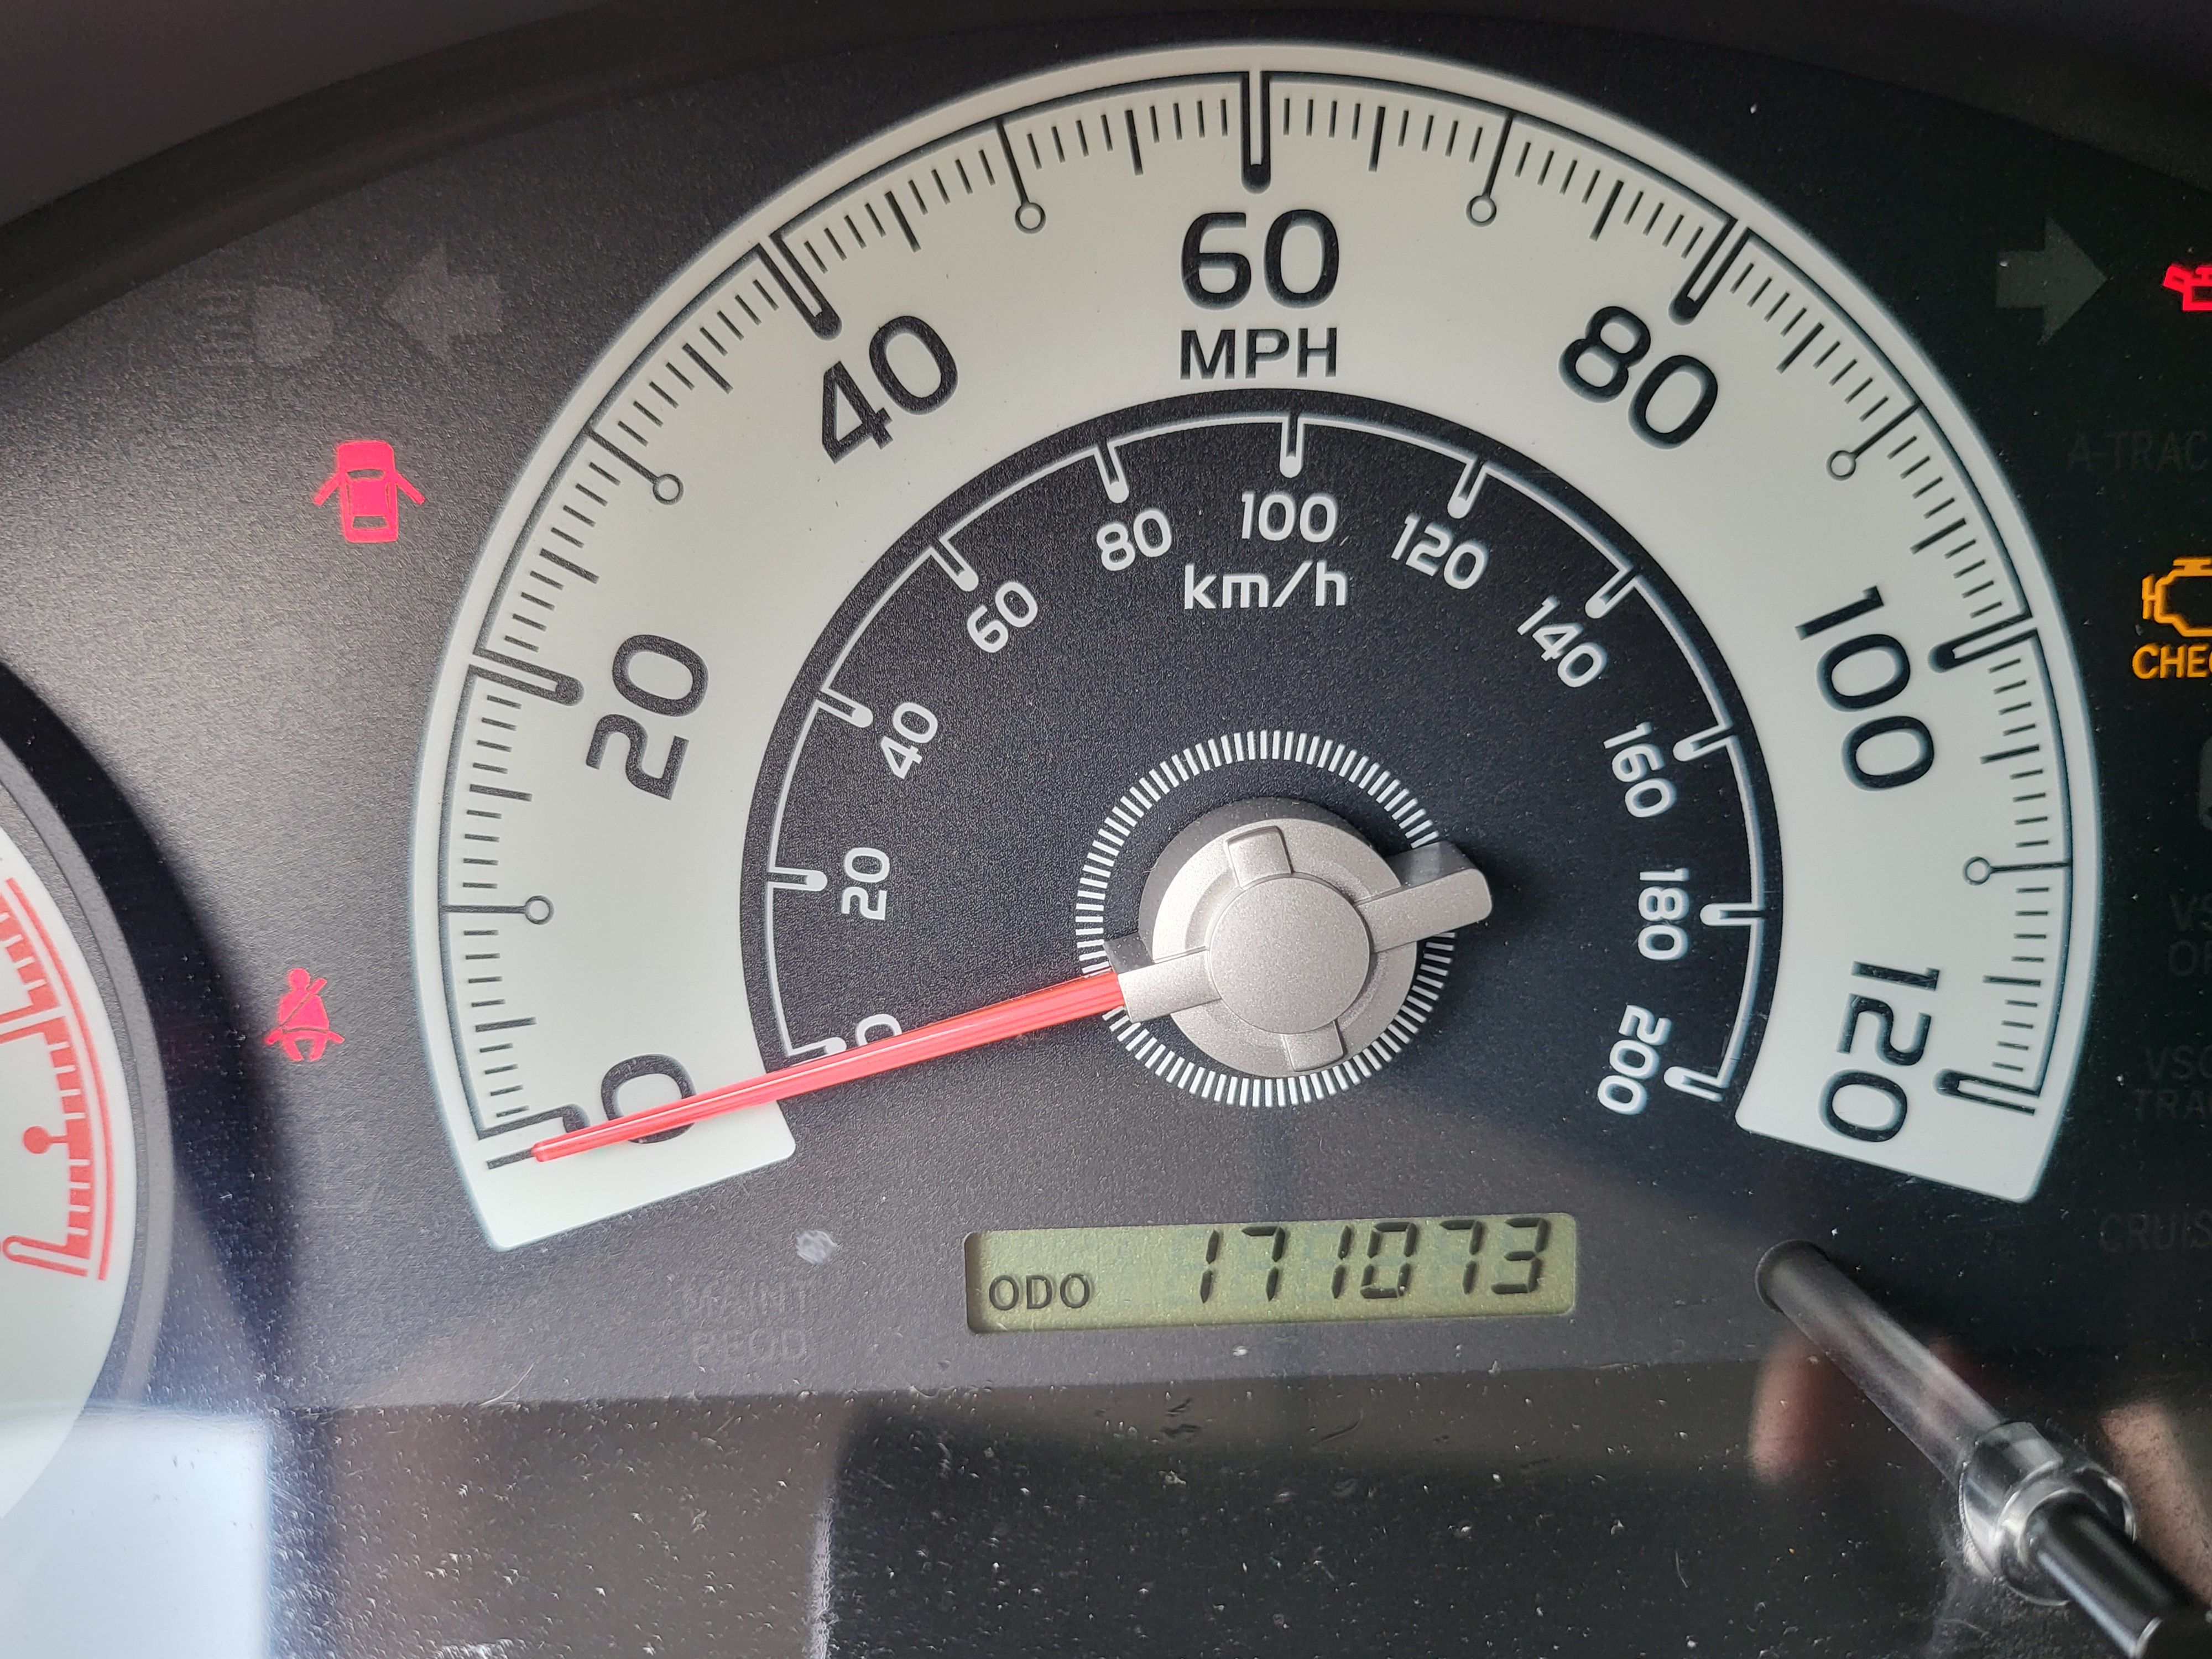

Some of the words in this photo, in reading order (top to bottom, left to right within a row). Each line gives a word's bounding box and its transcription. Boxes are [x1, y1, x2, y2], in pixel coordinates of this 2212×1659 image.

[1182, 208, 1339, 307] 60
[822, 315, 957, 462] 40
[1181, 327, 1337, 378] MPH
[1561, 306, 1718, 447] 80
[1097, 509, 1172, 571] 80
[1242, 492, 1337, 542] 100
[1391, 515, 1486, 589] 120
[967, 581, 1037, 653] 60
[1185, 561, 1347, 609] km/h
[1518, 598, 1605, 687] 140
[1795, 586, 1935, 790] 100
[2132, 643, 2212, 679] CHE
[586, 634, 707, 799] 20
[880, 702, 938, 779] 40
[1604, 723, 1674, 817] 160
[841, 847, 890, 920] 20
[1638, 869, 1687, 960] 180
[1598, 1005, 1670, 1114] 200
[1819, 963, 1940, 1142] 120
[601, 1053, 698, 1144] 0
[988, 1273, 1091, 1311] ODO
[1199, 1217, 1548, 1304] 171073
